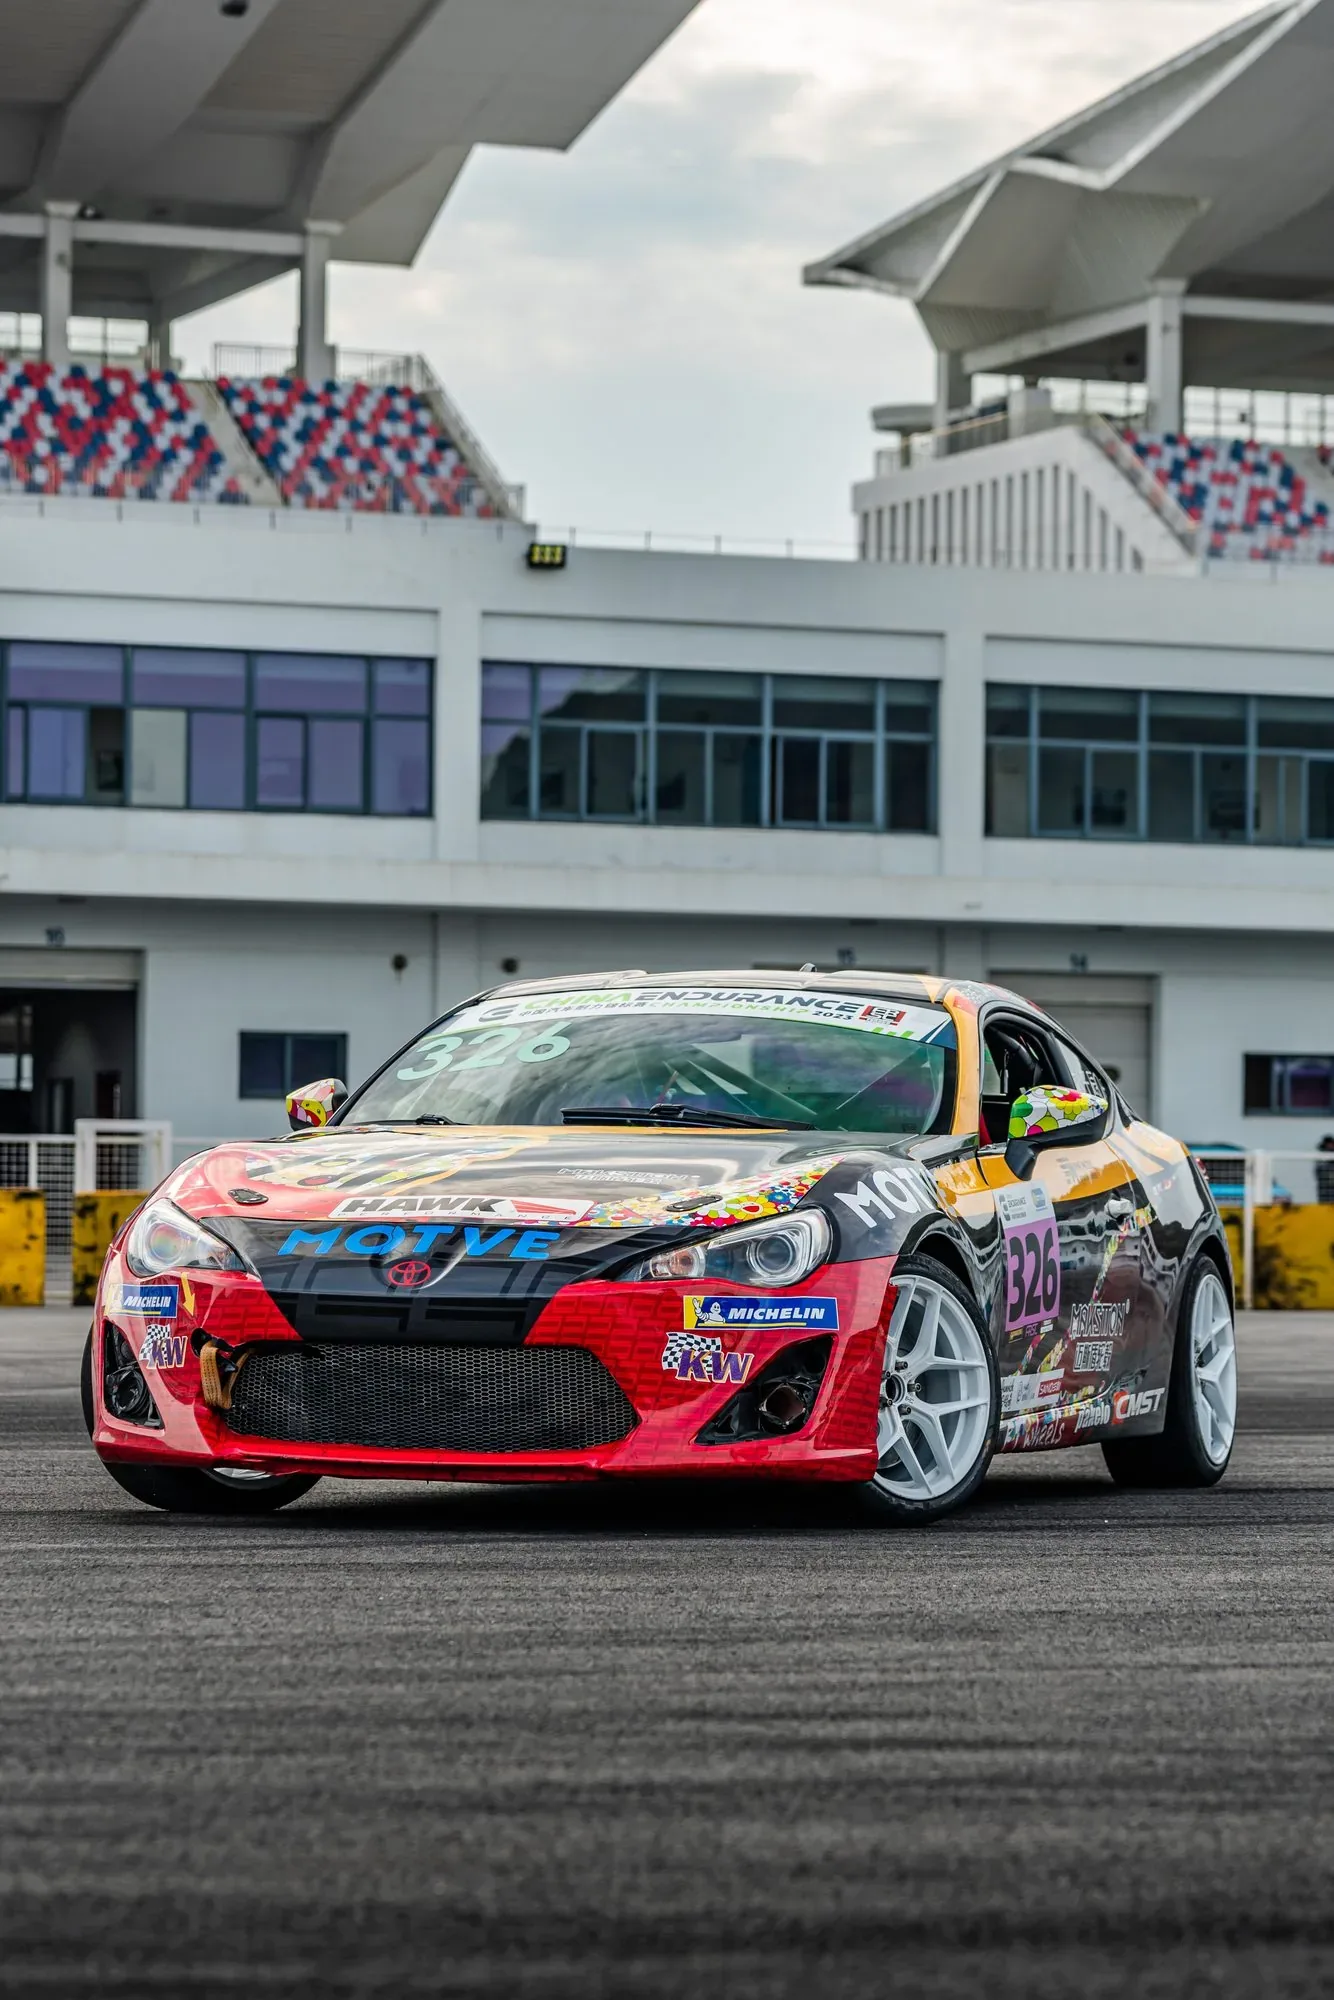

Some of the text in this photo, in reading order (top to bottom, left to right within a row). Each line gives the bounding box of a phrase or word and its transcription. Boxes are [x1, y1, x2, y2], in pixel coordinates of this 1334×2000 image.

[396, 1021, 571, 1081] 326
[336, 1211, 573, 1221] PERFORMANCE
[341, 1197, 506, 1213] HAWK
[1009, 1228, 1058, 1323] 326
[124, 1295, 172, 1308] MICHELIN
[728, 1307, 825, 1320] MICHELIN
[148, 1336, 188, 1369] KW
[676, 1347, 754, 1384] KW
[1116, 1387, 1165, 1420] CMST
